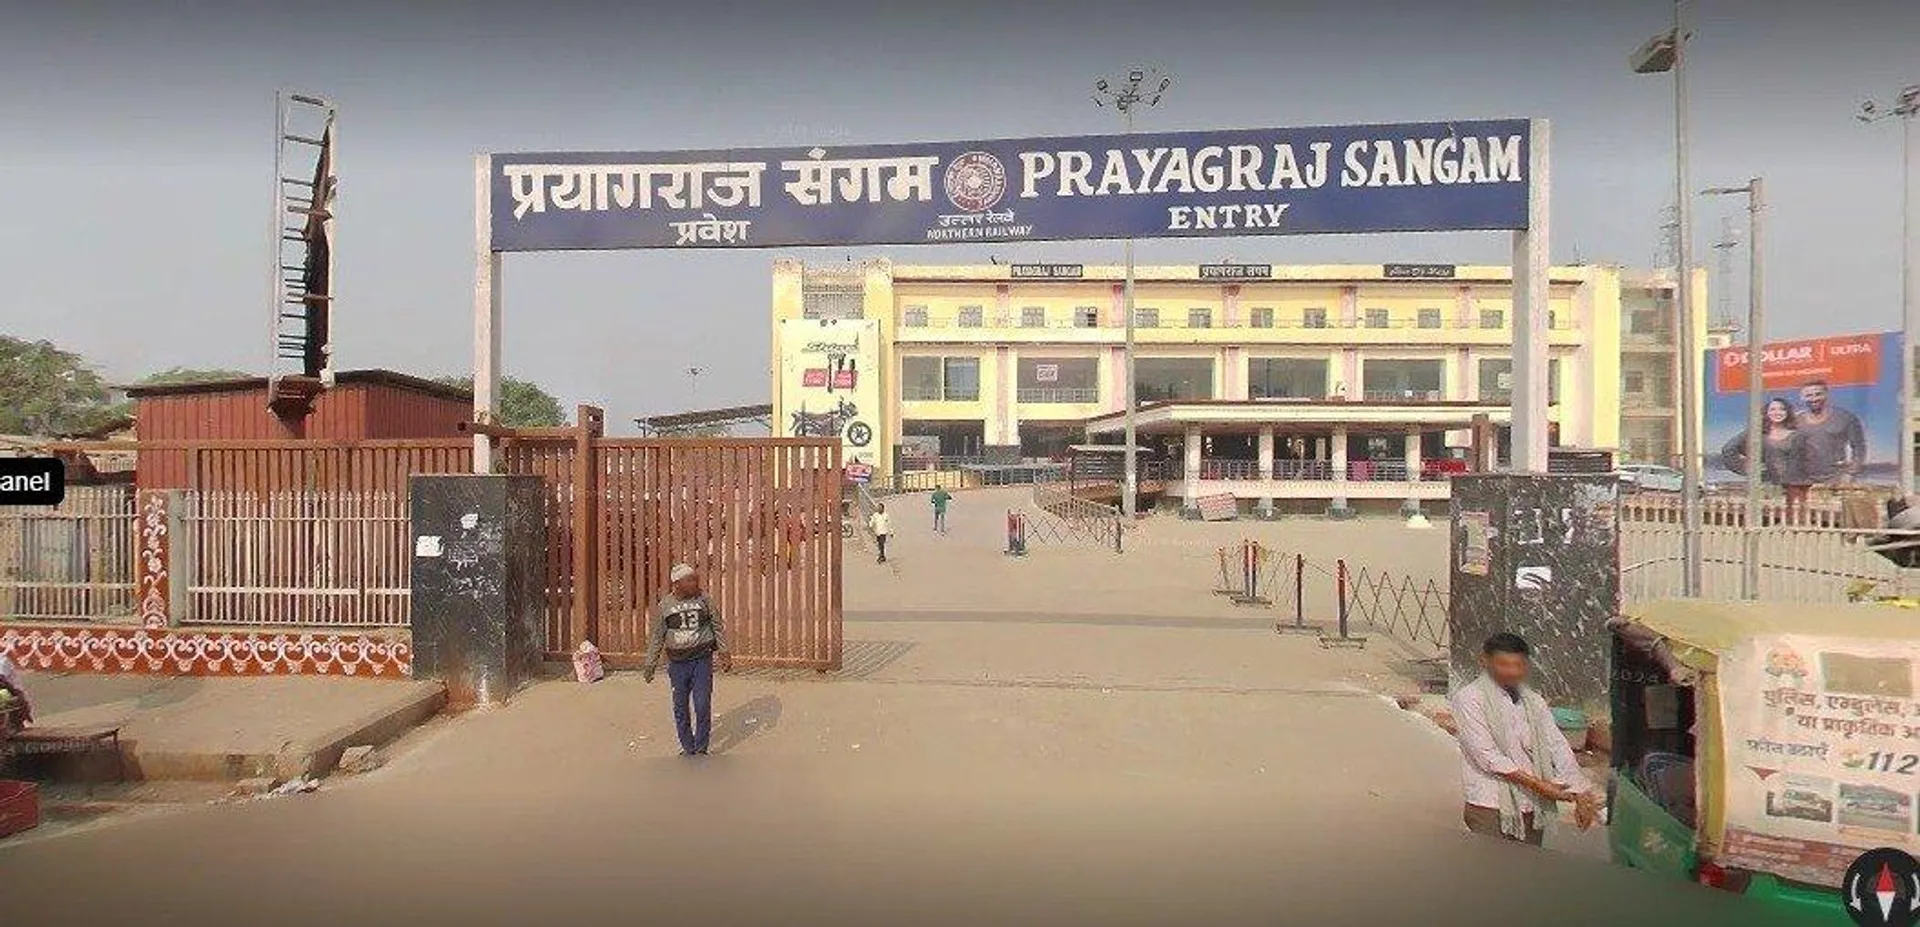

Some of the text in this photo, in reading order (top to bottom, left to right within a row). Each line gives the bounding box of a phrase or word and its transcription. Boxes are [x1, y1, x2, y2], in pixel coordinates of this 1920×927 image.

[1018, 141, 1332, 199] PRAYAGRAJ
[1340, 133, 1522, 188] SANGAM
[503, 161, 767, 221] प्रयागराज
[781, 147, 939, 206] संगम
[668, 213, 751, 247] प्रवेश
[1166, 202, 1291, 231] ENTRY
[926, 224, 1034, 240] NORTHERN RAILWAY
[679, 612, 700, 629] 13
[1867, 751, 1919, 776] 112
